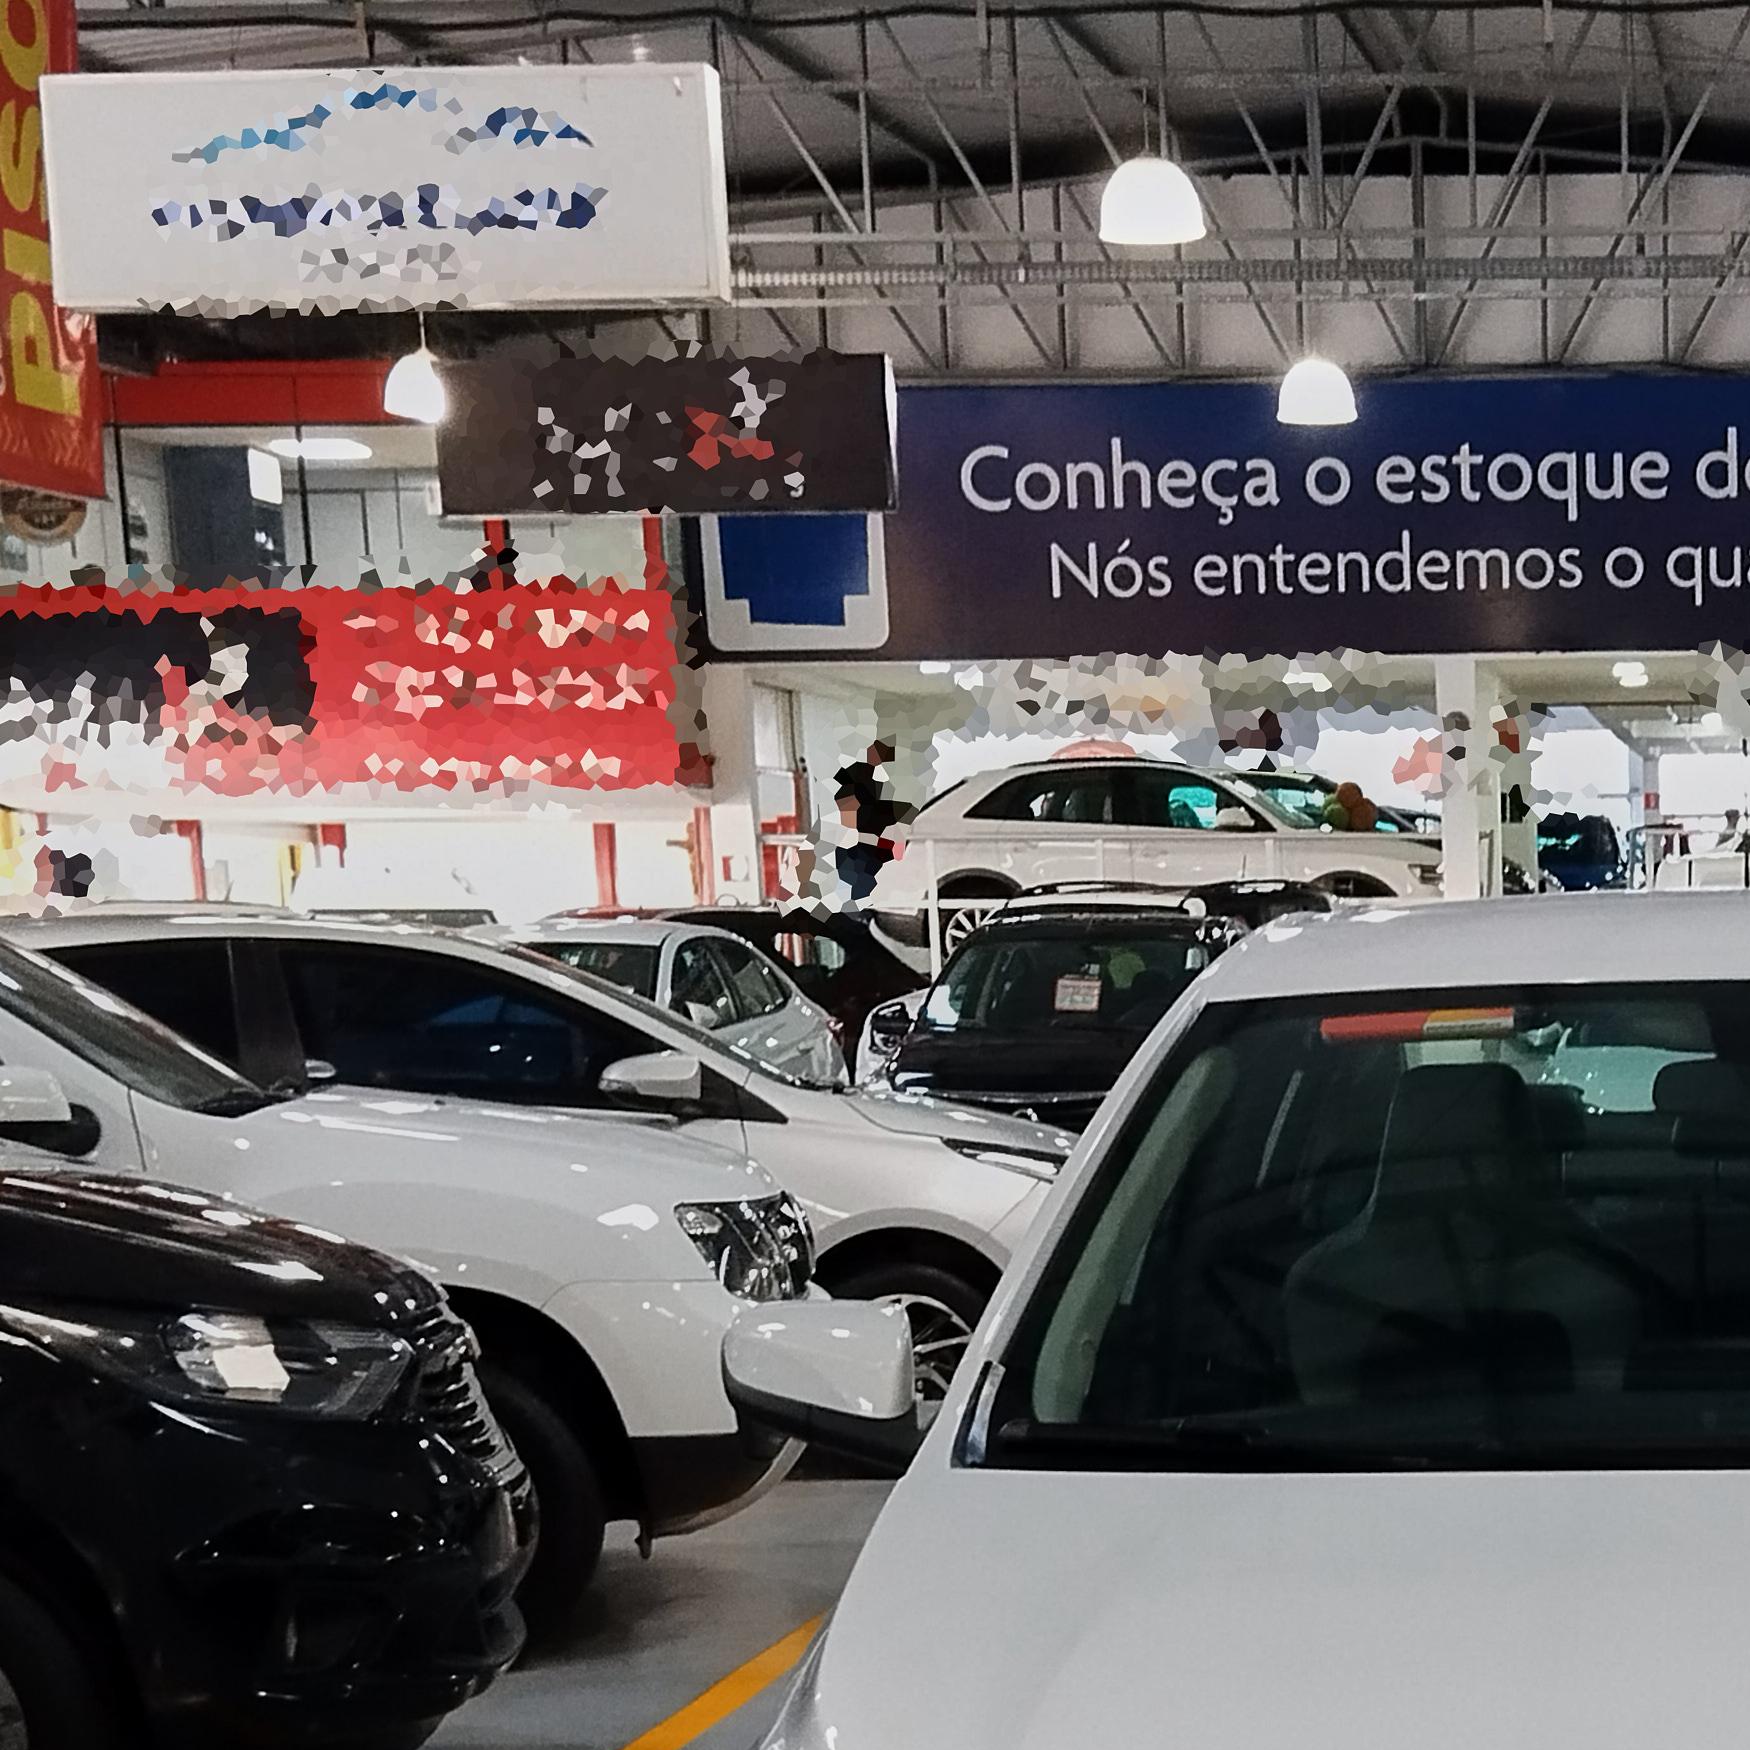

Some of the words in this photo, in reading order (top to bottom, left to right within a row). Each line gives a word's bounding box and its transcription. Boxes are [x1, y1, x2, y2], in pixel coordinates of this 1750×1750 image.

[0, 0, 82, 417] PISO
[959, 436, 1281, 526] Conheça
[1305, 456, 1352, 506] o
[1375, 442, 1671, 522] estoque
[1050, 537, 1172, 599] Nós
[1193, 530, 1584, 597] entendemos
[1604, 546, 1644, 589] o
